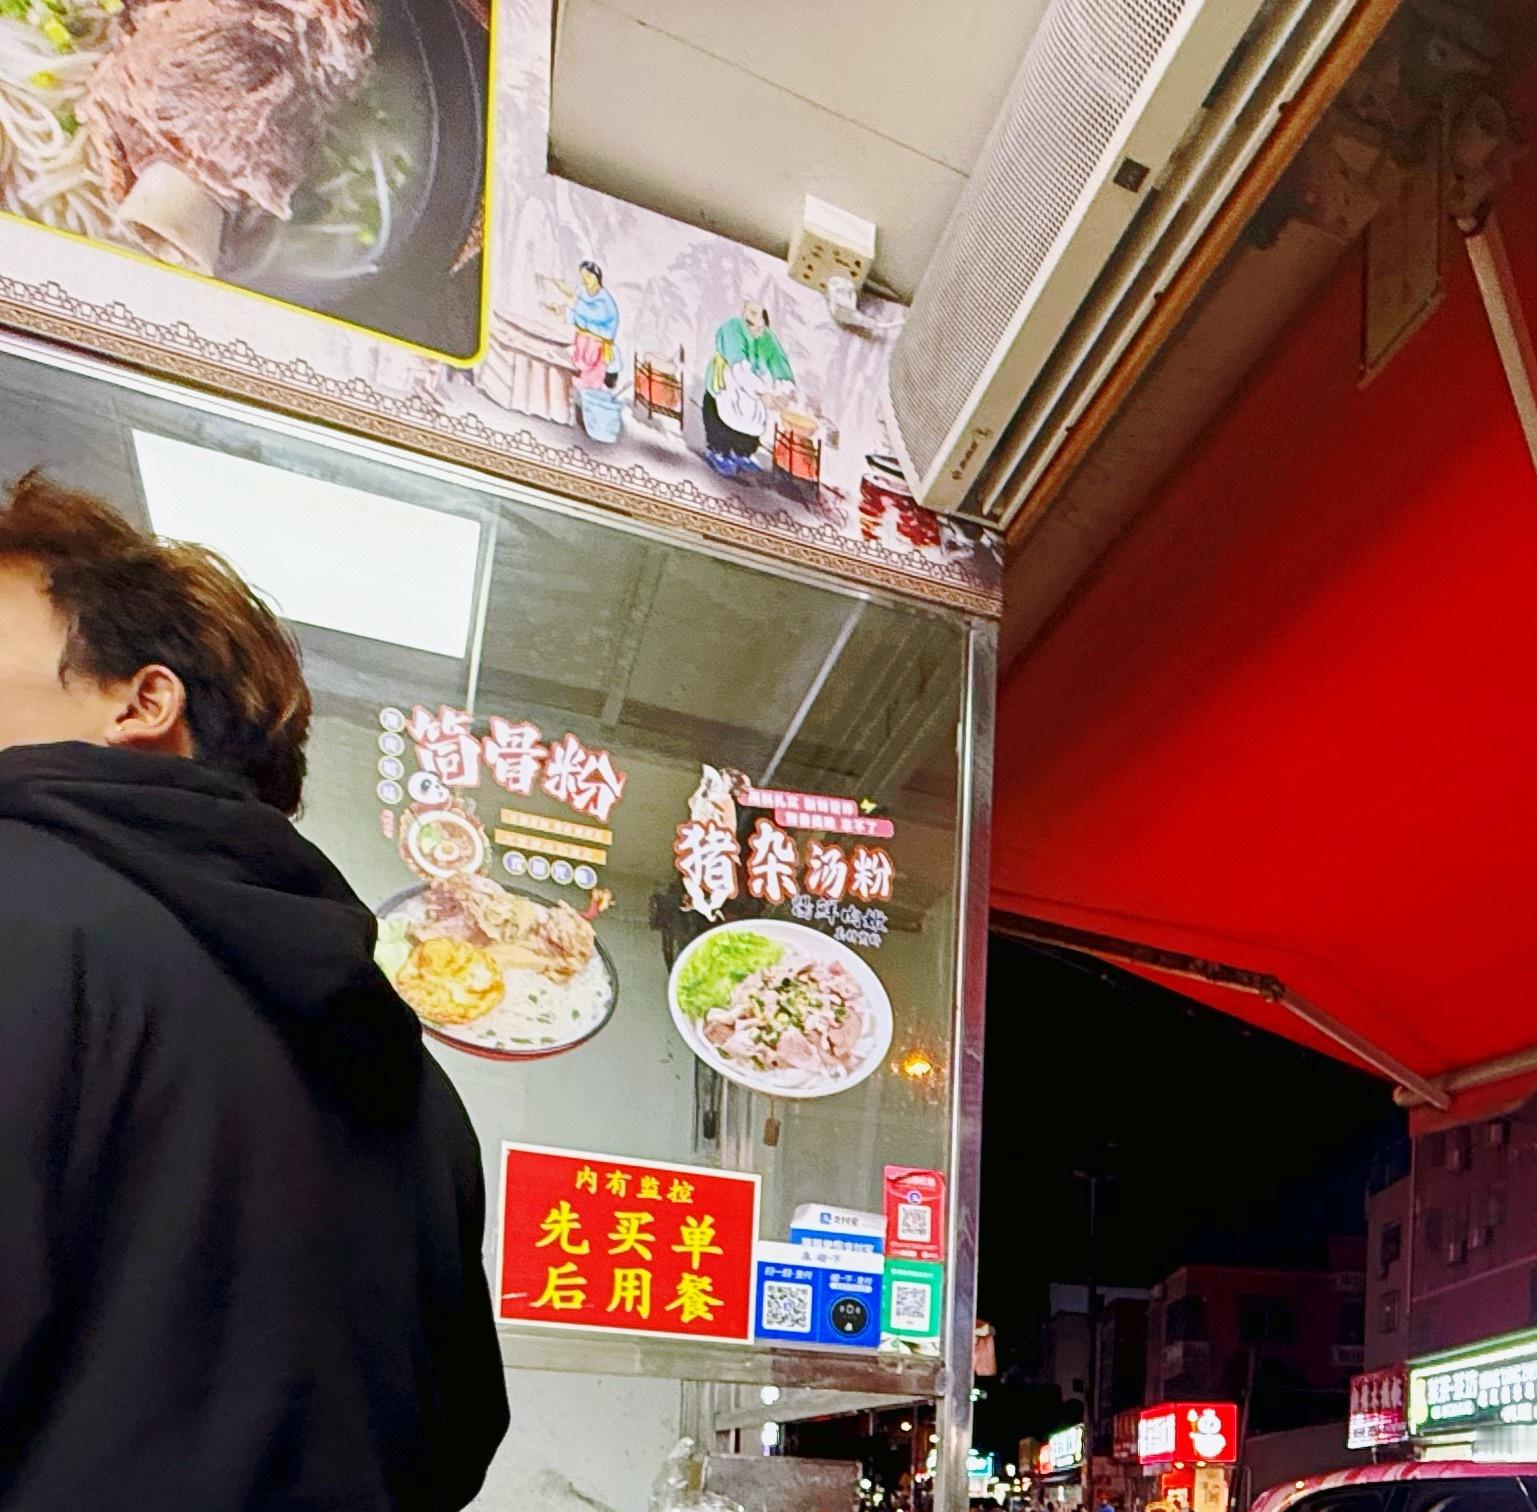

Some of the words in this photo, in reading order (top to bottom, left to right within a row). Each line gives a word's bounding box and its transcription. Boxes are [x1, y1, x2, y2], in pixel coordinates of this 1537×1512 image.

[406, 705, 627, 820] 筒骨粉
[675, 818, 895, 902] 猪杂汤粉
[574, 1164, 696, 1205] 内有监控
[534, 1200, 724, 1270] 先买单
[530, 1261, 725, 1324] 后用餐
